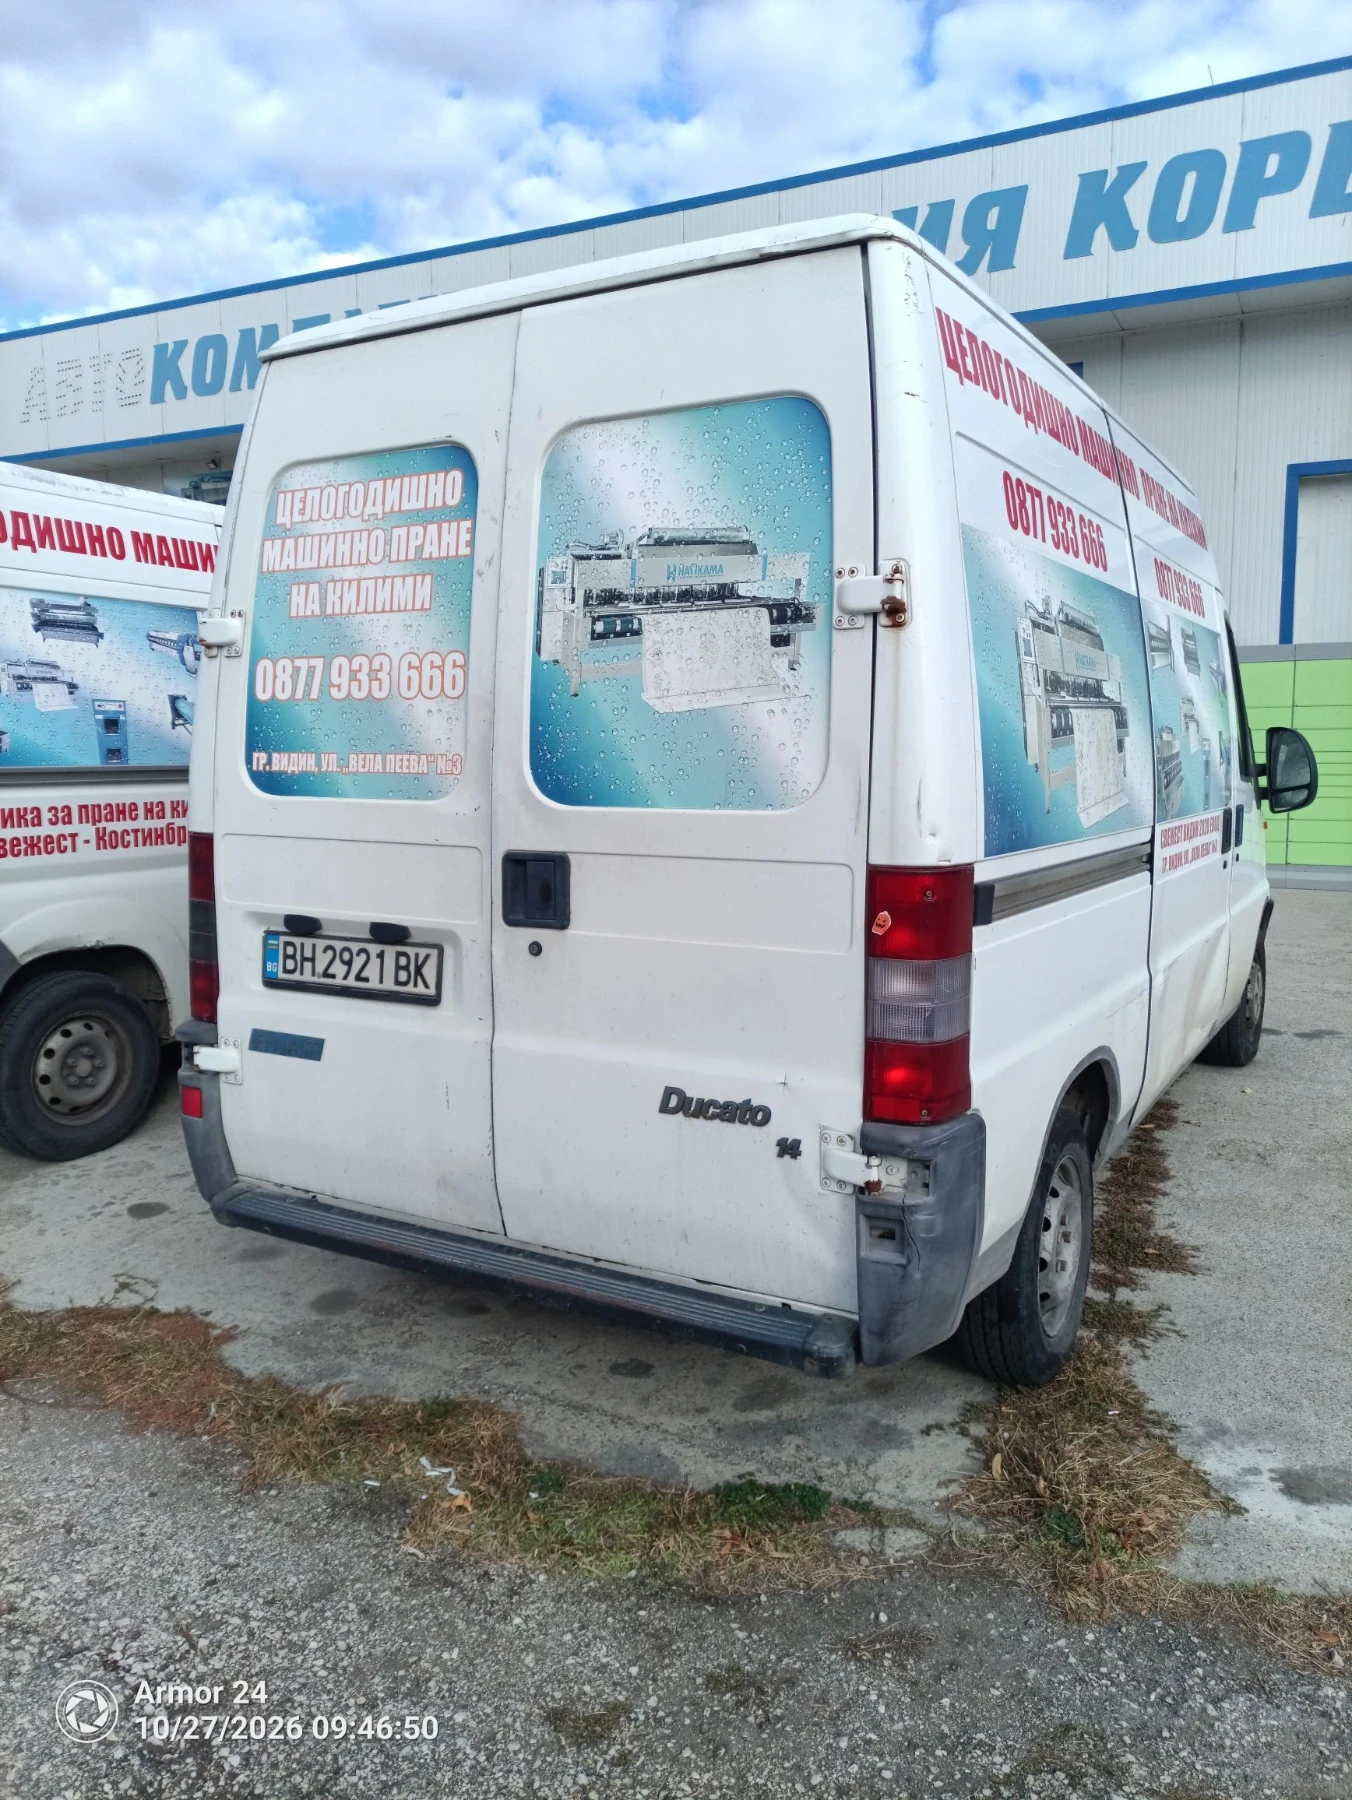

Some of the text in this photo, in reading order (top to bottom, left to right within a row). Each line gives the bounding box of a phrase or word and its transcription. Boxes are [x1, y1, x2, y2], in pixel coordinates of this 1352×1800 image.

[935, 305, 1080, 456] ЦЕЛОГОДИШНО
[274, 468, 464, 529] ЦЕЛОГОДИШНО
[1002, 470, 1108, 573] 0877 933 666
[261, 519, 474, 573] МАШИННО ПРАНЕ
[289, 573, 433, 618] НА КИЛИМИ
[1153, 556, 1206, 619] 0877 933 666
[254, 651, 467, 702] 0877 933 666
[252, 752, 271, 772] ГР.
[47, 804, 73, 826] за
[77, 801, 139, 826] пране
[143, 800, 166, 821] на
[94, 822, 187, 851] Костинбр
[266, 960, 278, 972] BG
[658, 1085, 772, 1127] Ducato
[776, 1137, 803, 1160] 14
